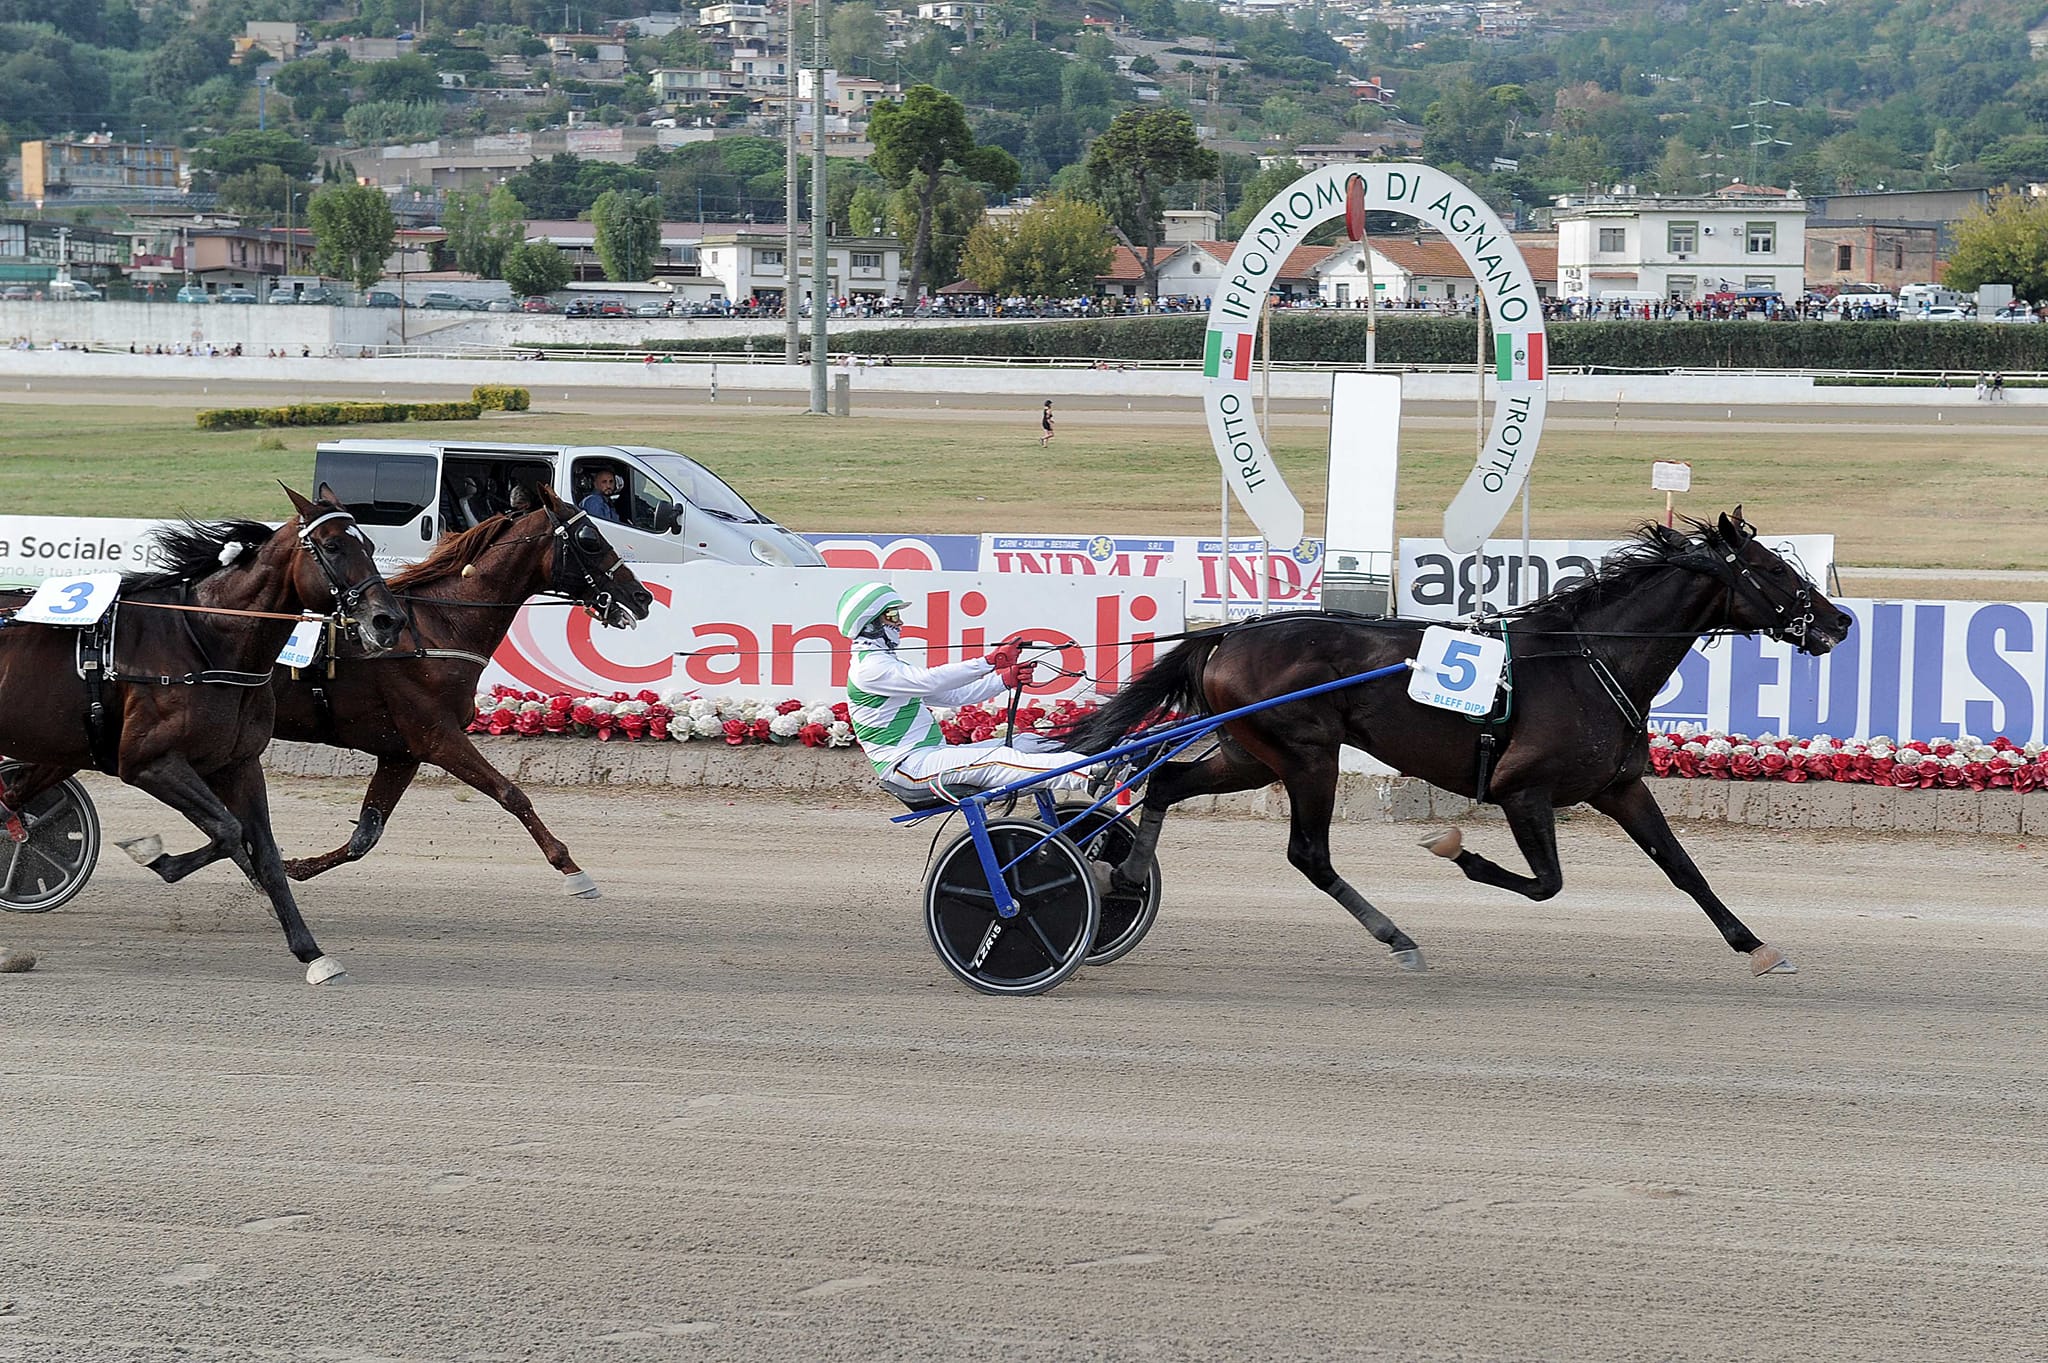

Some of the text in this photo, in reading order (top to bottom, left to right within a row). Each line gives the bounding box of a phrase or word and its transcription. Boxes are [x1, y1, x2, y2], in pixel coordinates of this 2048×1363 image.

[1222, 172, 1528, 322] IPPODROMO DI AGNANO
[1220, 394, 1266, 494] TROTTO
[1483, 396, 1531, 493] TROTTO
[20, 536, 122, 560] Sociale
[48, 581, 95, 614] 3
[1436, 639, 1482, 692] 5
[1729, 603, 2048, 746] EDILS
[1433, 694, 1463, 708] BLEFF
[1464, 702, 1486, 714] DIPA
